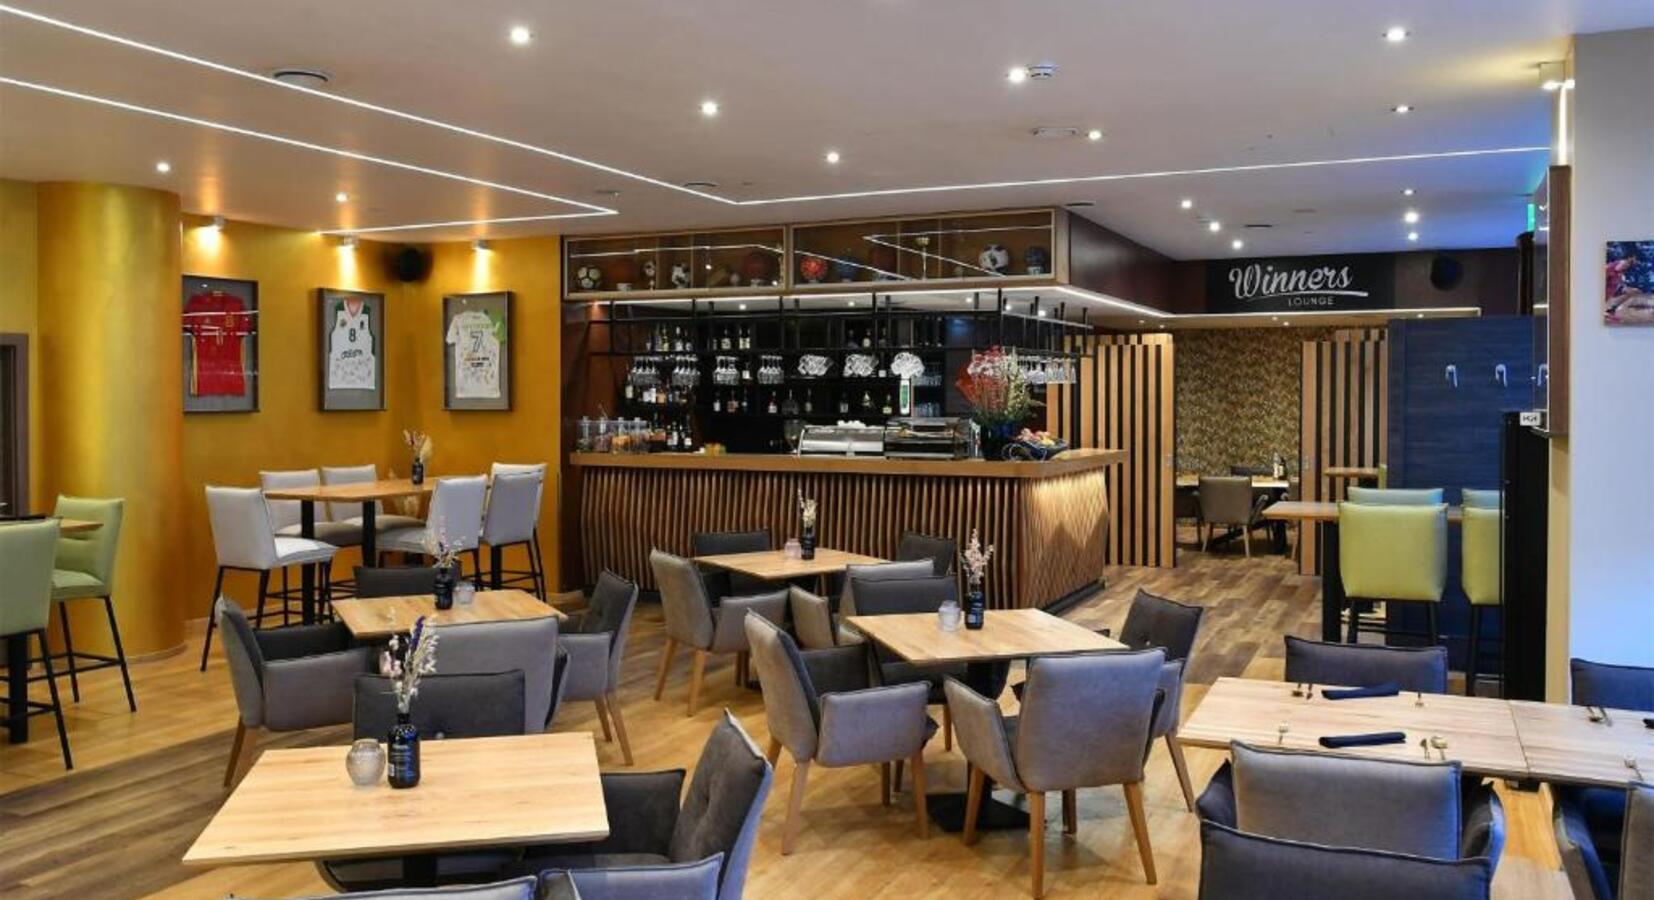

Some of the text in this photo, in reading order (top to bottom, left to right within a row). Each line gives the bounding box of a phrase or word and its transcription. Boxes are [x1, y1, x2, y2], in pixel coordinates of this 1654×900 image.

[1229, 263, 1354, 299] Winners
[1288, 297, 1334, 306] LOUNGE
[348, 328, 356, 342] 8
[470, 330, 483, 353] 7
